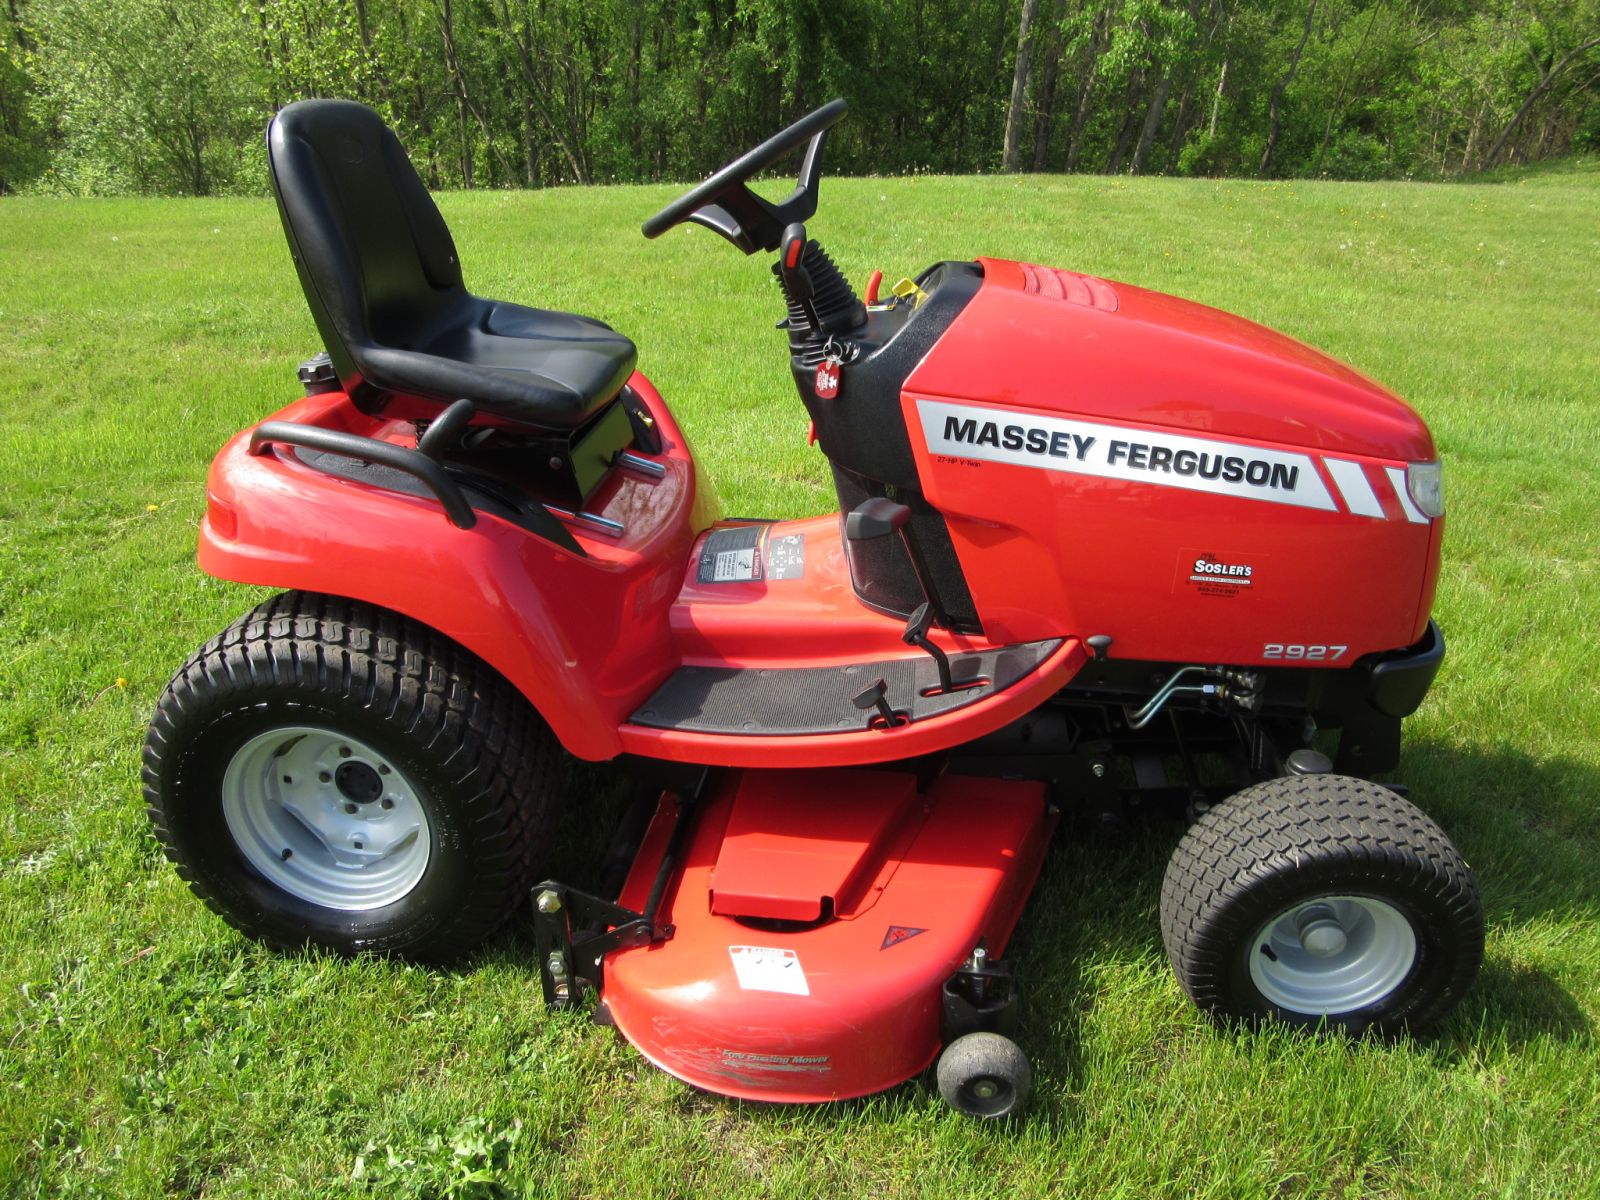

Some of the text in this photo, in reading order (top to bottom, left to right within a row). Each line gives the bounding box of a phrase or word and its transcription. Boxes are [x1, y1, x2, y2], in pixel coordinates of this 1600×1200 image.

[943, 416, 1299, 491] MASSEY FERGUSON
[1194, 559, 1252, 576] SOSLER'S
[1263, 643, 1348, 660] 2927
[792, 1056, 830, 1064] Mower
